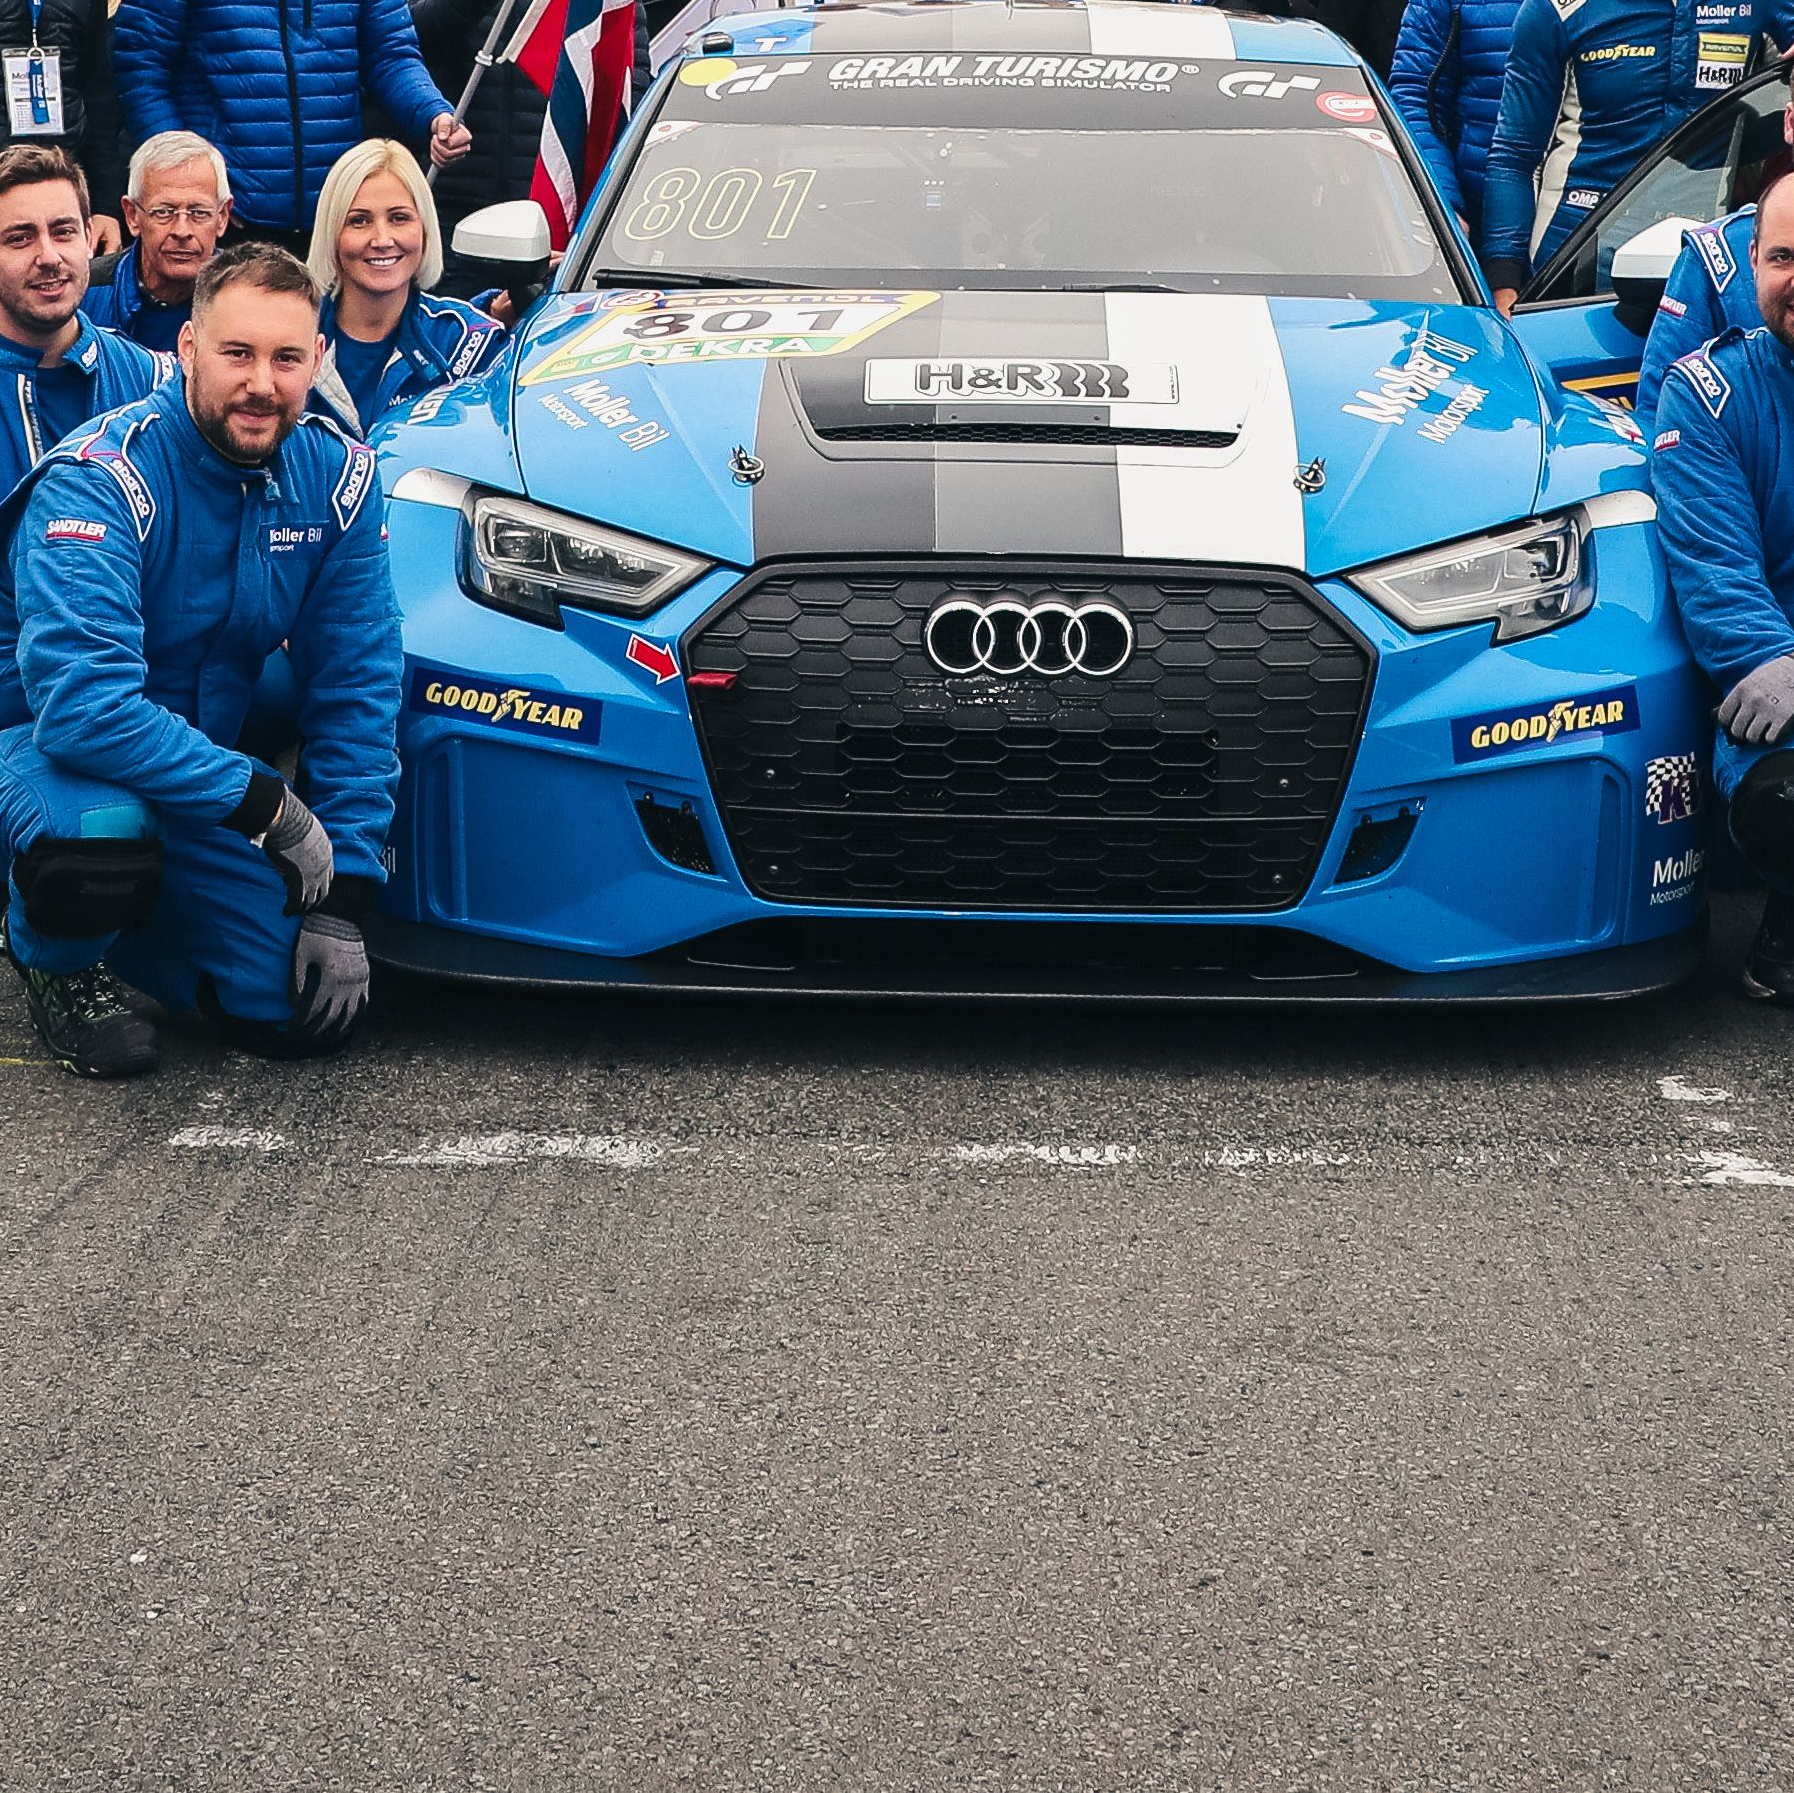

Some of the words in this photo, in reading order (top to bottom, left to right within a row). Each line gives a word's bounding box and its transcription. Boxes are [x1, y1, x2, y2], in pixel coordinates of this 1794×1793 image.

[755, 37, 787, 52] T
[1580, 44, 1656, 61] GOODYEAR
[828, 56, 961, 81] GRAN
[830, 80, 873, 90] THE
[879, 78, 937, 89] REAL
[943, 77, 1035, 87] DRIVING
[1041, 79, 1171, 93] SIMULATOR
[625, 167, 817, 240] 801
[1568, 190, 1599, 205] OMP
[1701, 232, 1729, 275] sparco
[664, 294, 884, 307] RAVENOL
[623, 309, 848, 340] 801
[453, 330, 484, 376] sparco
[627, 337, 815, 360] DEKRA
[1685, 357, 1722, 399] sparco
[537, 393, 589, 431] Motorsport
[1417, 383, 1490, 445] Motorsport
[620, 420, 671, 452] Bil
[111, 459, 151, 518] sparco
[340, 453, 368, 509] sparco
[47, 519, 106, 538] SANDTLER
[308, 527, 323, 543] Bil
[426, 681, 584, 731] GOODYEAR
[1470, 700, 1625, 749] GOODYEAR
